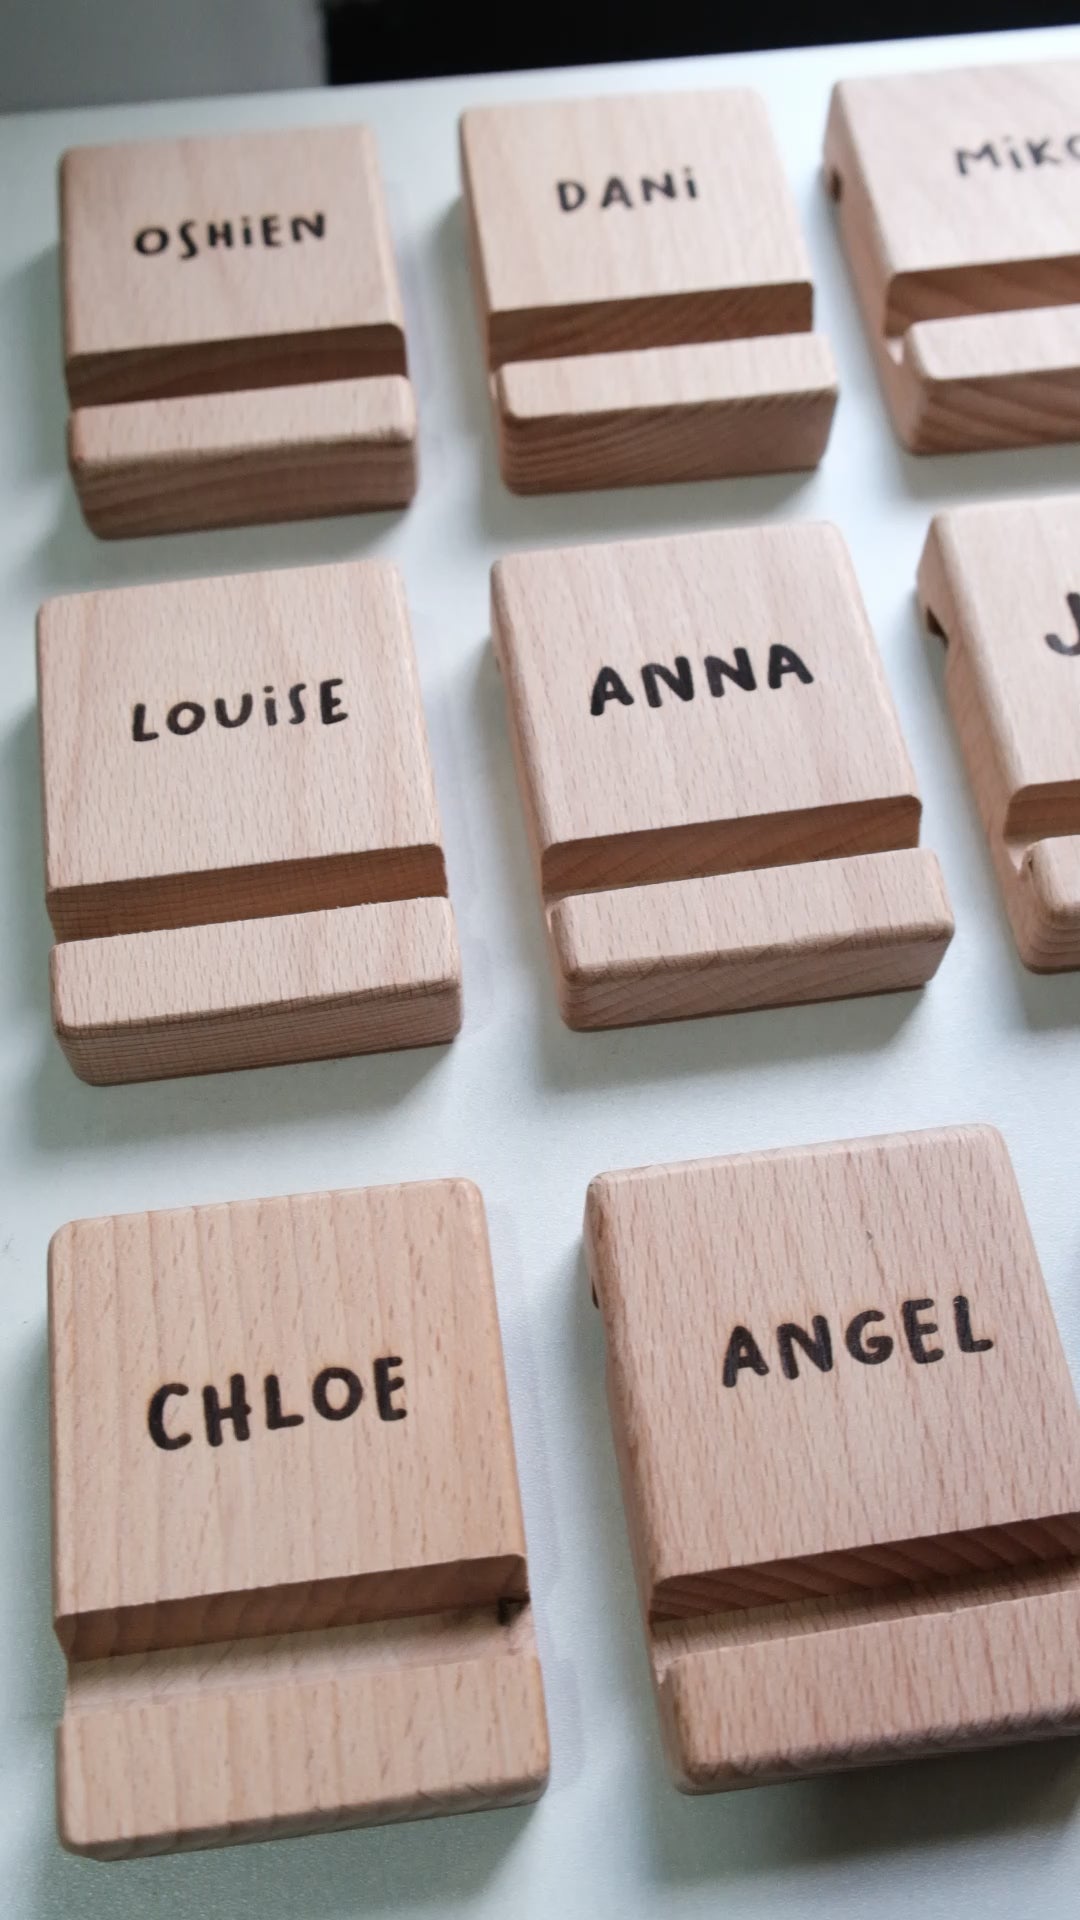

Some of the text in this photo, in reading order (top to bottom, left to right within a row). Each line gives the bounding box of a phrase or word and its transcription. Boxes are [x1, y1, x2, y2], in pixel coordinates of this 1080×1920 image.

[556, 166, 698, 214] DANi
[133, 212, 326, 260] OSHiEN
[132, 678, 349, 742] LOUiSE
[589, 643, 814, 717] ANNA
[722, 1294, 994, 1389] ANGEL
[146, 1355, 407, 1451] CHLOE
